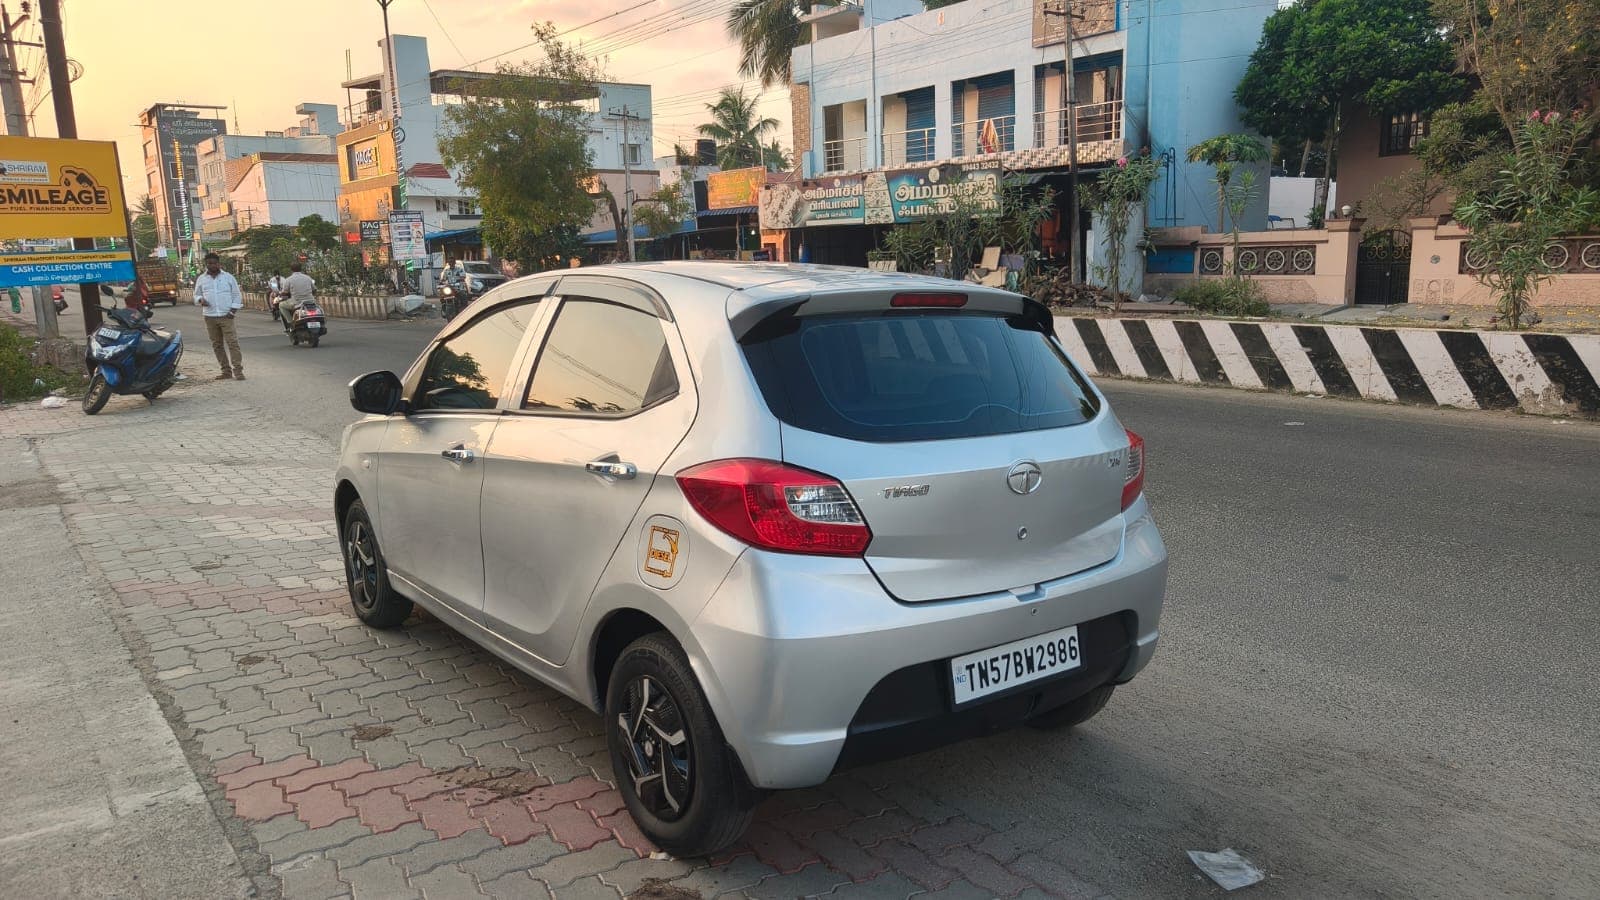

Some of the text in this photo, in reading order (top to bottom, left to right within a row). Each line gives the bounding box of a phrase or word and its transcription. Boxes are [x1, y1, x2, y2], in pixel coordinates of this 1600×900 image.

[7, 164, 47, 173] SHRIRAM
[11, 262, 112, 273] CASH COLLECTION CENTRE
[965, 635, 1078, 691] TN57BW2986
